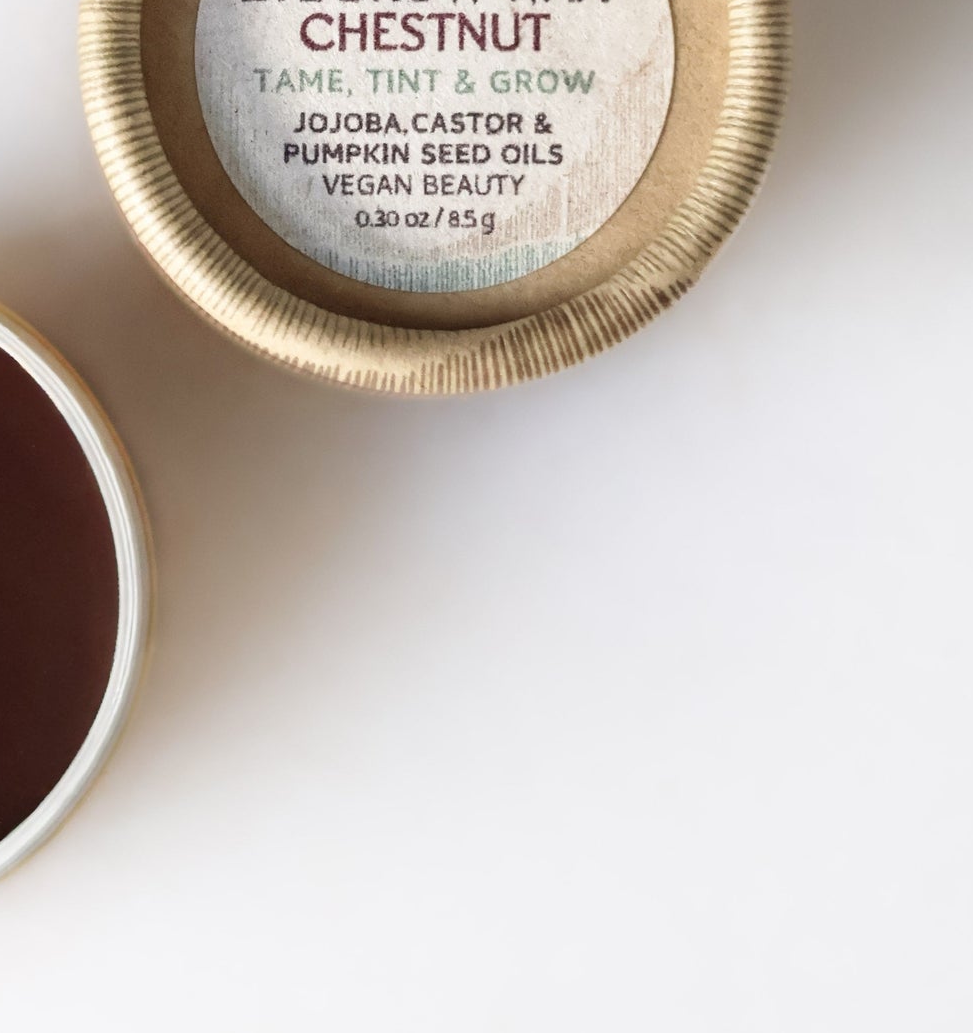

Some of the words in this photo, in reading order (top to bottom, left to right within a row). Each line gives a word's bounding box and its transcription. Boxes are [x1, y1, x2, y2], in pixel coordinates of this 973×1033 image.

[299, 12, 551, 53] CHESTNUT
[253, 68, 353, 97] TAME,
[369, 68, 439, 94] TINT
[454, 68, 477, 94] &
[490, 68, 596, 95] GROW
[534, 112, 553, 135] &
[283, 142, 411, 166] PUMPKIN
[421, 143, 491, 166] SEED
[501, 142, 564, 165] OILS
[323, 173, 413, 197] VEGAN
[424, 173, 526, 196] BEAUTY
[355, 210, 400, 229] 0.30
[405, 213, 430, 229] oz
[433, 207, 445, 229] /
[481, 213, 496, 235] g
